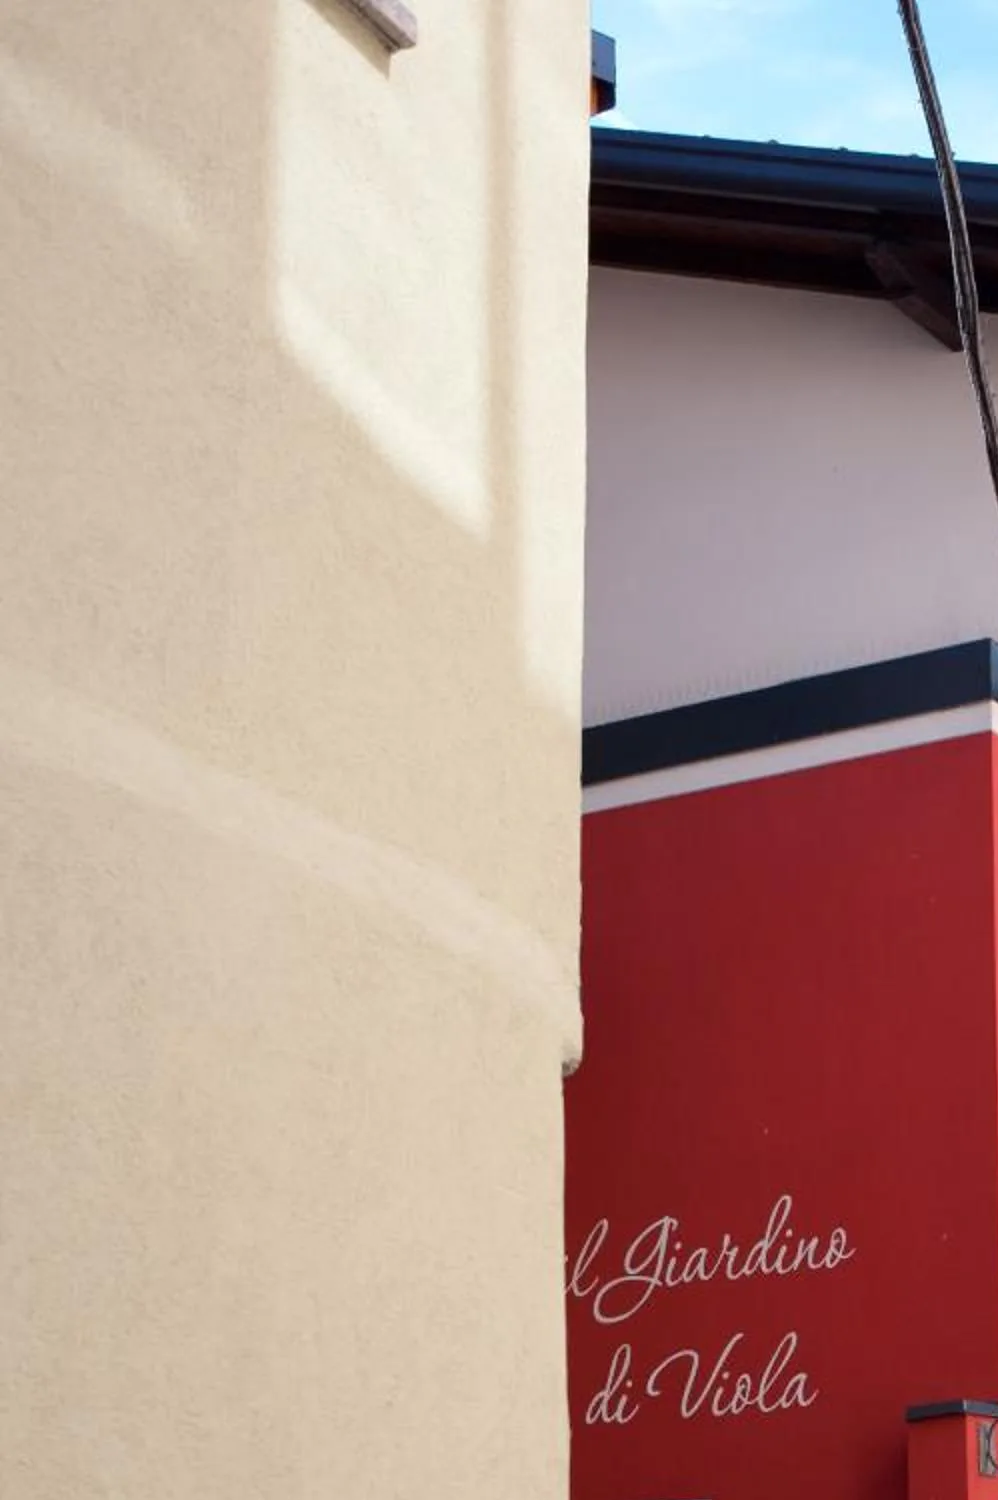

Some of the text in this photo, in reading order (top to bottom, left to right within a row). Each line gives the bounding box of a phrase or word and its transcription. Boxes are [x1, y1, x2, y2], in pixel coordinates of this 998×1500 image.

[564, 1194, 856, 1324] l Giardino
[585, 1331, 819, 1425] di Viola
